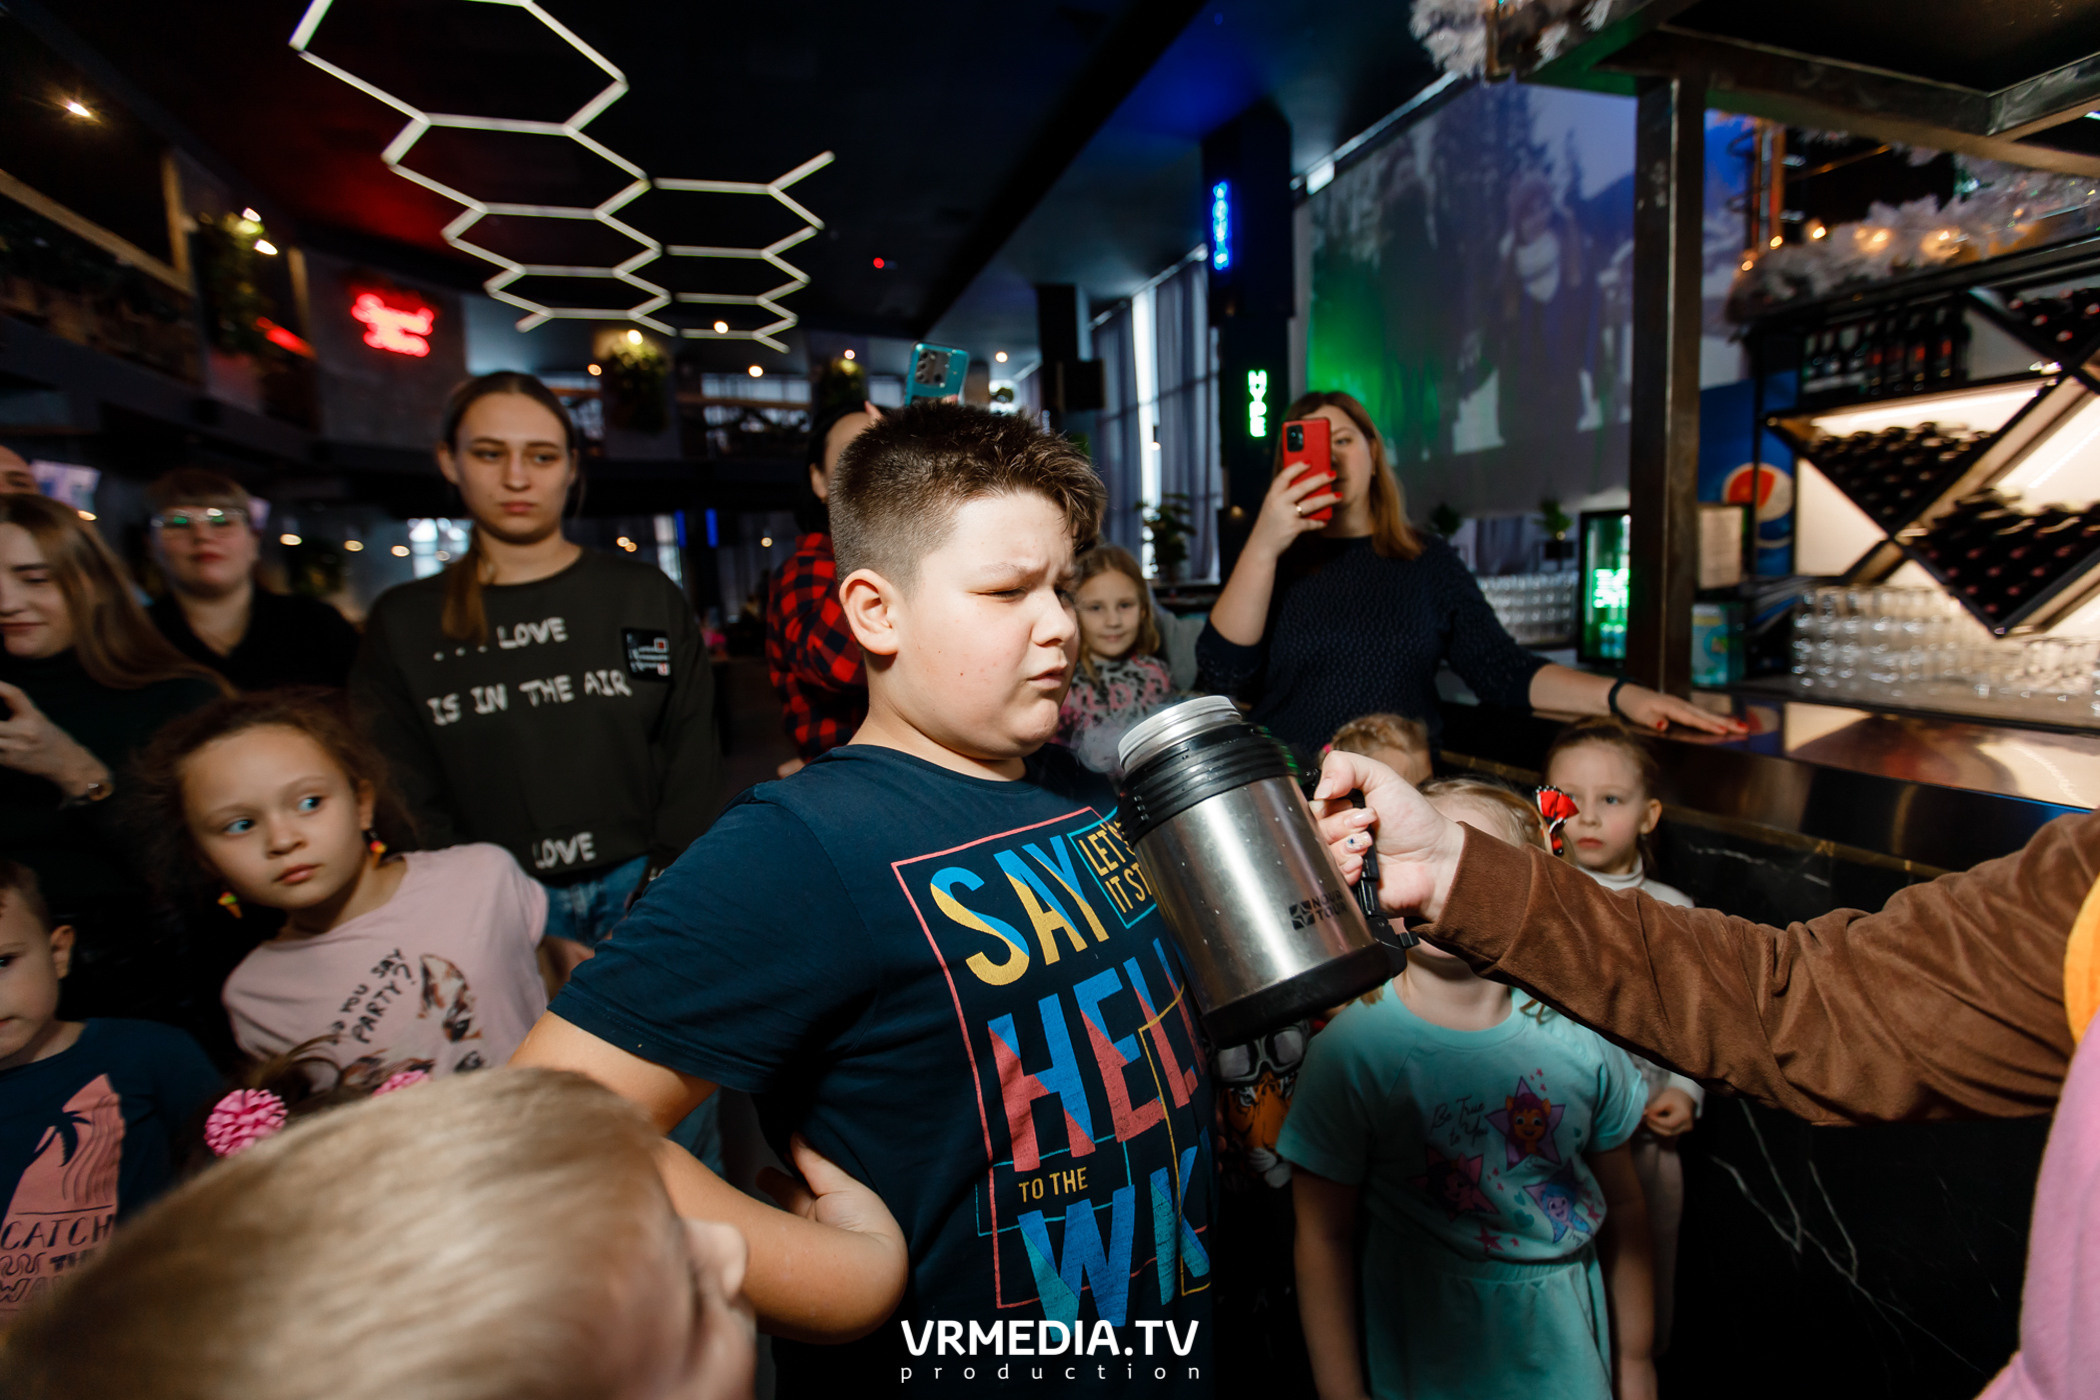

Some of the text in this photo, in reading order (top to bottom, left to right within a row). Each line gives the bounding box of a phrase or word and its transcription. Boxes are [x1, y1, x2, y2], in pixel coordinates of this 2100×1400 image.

[1248, 369, 1268, 438] HYPE
[497, 617, 568, 649] LOVE
[427, 669, 633, 726] IS IN THE AIR
[532, 831, 598, 869] LOVE
[929, 834, 1110, 986] SAY
[1104, 862, 1152, 914] IT ST
[987, 937, 1206, 1172] HELL
[1018, 1165, 1089, 1203] TO THE
[0, 1213, 114, 1251] CATCH
[1016, 1143, 1210, 1343] WK
